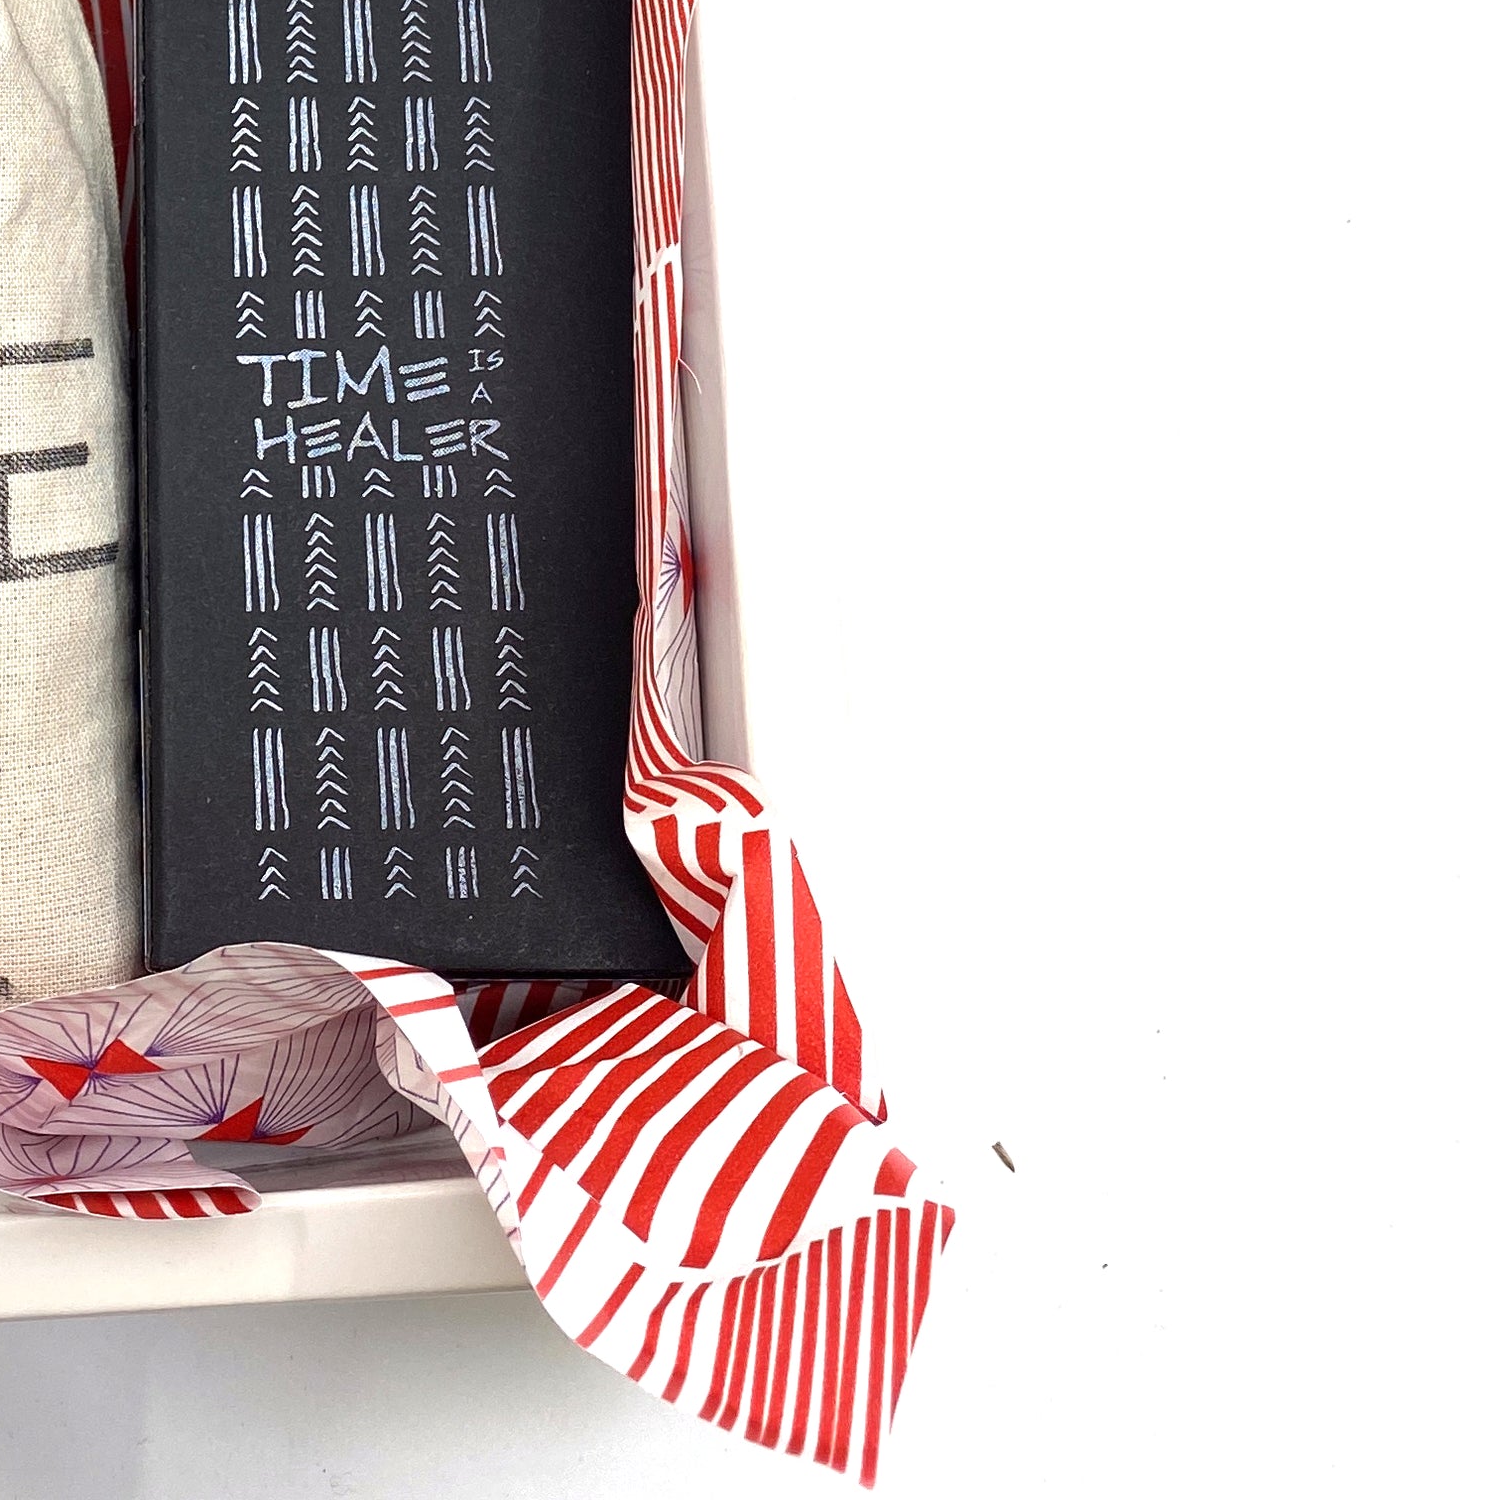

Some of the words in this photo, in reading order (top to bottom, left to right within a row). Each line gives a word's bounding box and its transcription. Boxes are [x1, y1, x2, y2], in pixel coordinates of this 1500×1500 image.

[236, 345, 450, 409] TIME
[468, 349, 505, 372] IS
[470, 381, 493, 404] A
[254, 411, 510, 464] HEALER
